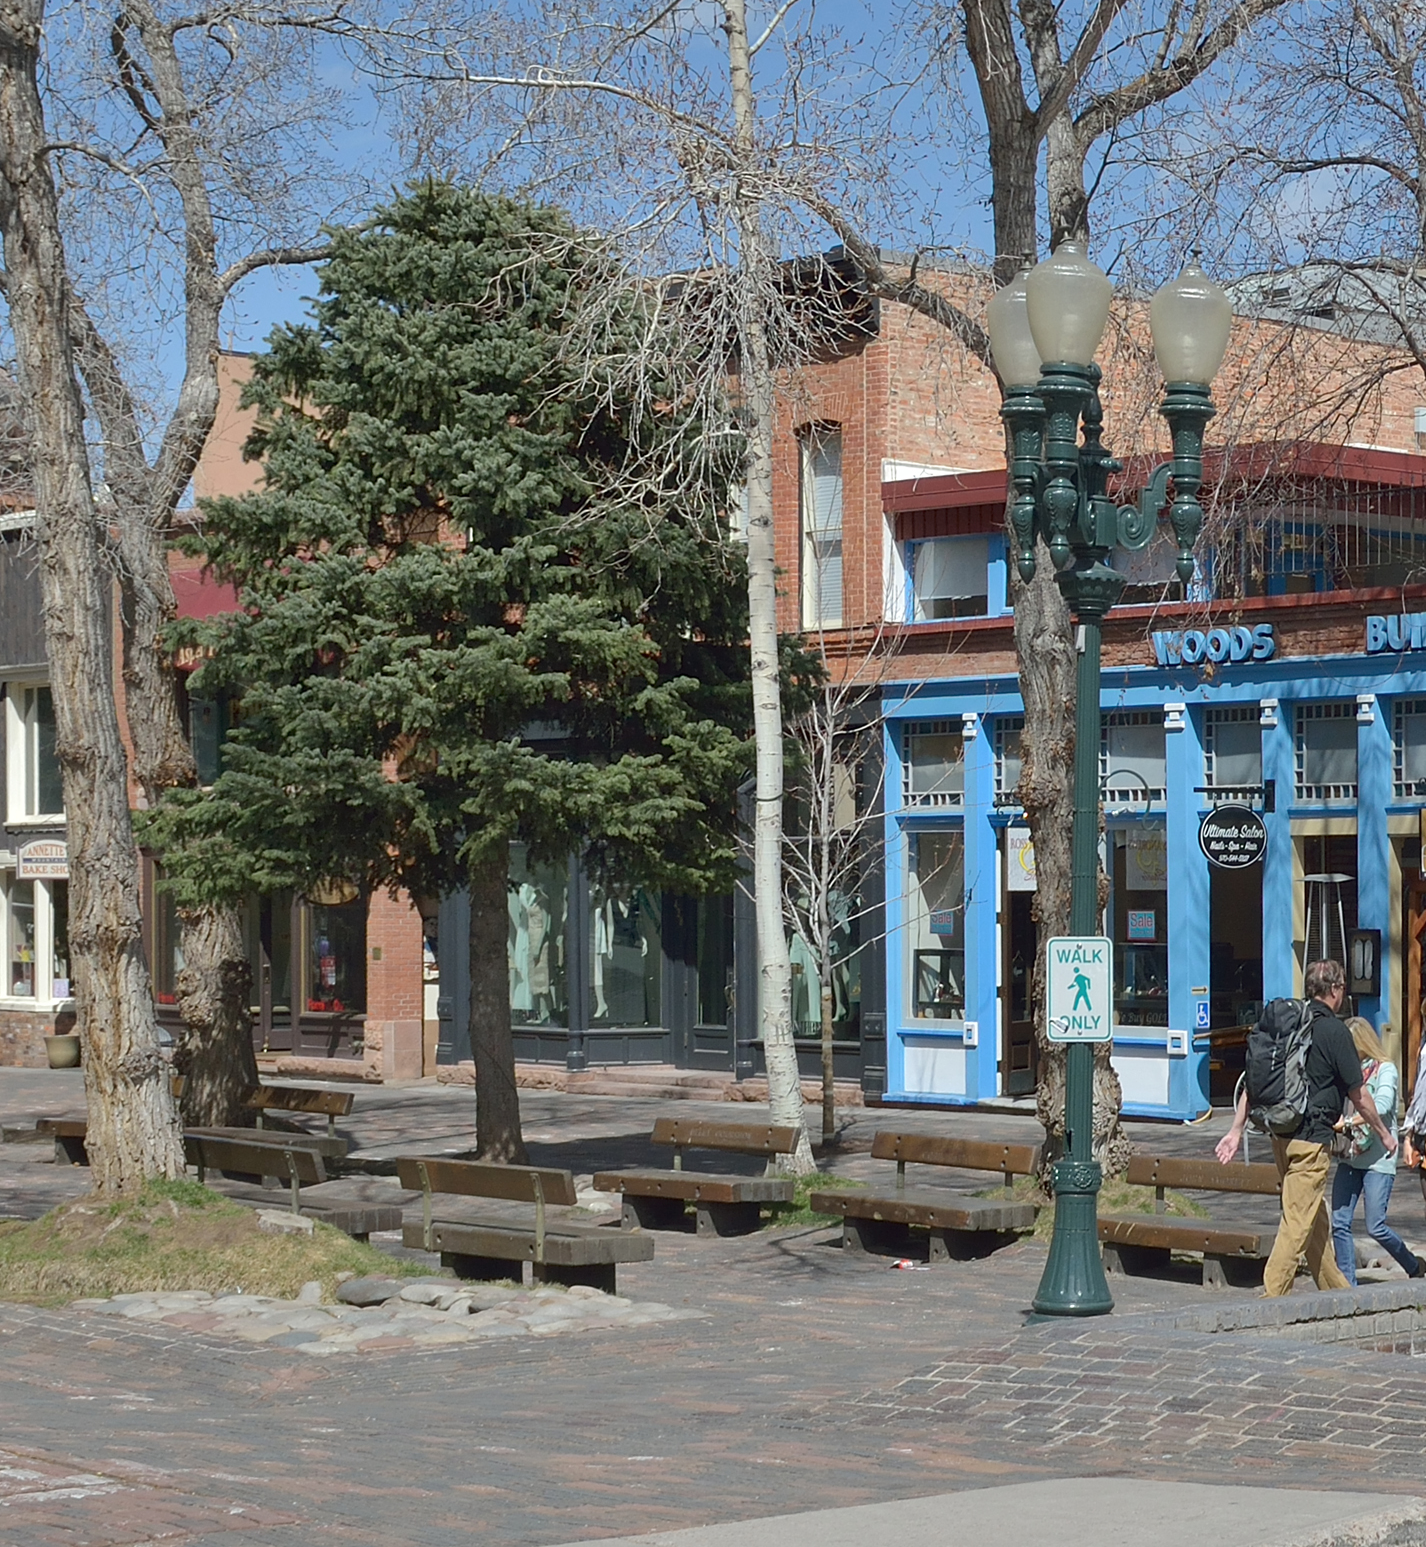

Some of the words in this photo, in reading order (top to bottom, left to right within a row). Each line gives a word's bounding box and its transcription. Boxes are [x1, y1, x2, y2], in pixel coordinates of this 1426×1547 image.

[1152, 623, 1275, 665] WOODS
[1203, 824, 1239, 838] Ultimate
[1240, 824, 1264, 839] Salon
[22, 865, 48, 874] BAKE
[50, 865, 68, 874] SHO
[1130, 912, 1154, 928] Sale
[1056, 949, 1103, 964] WALK
